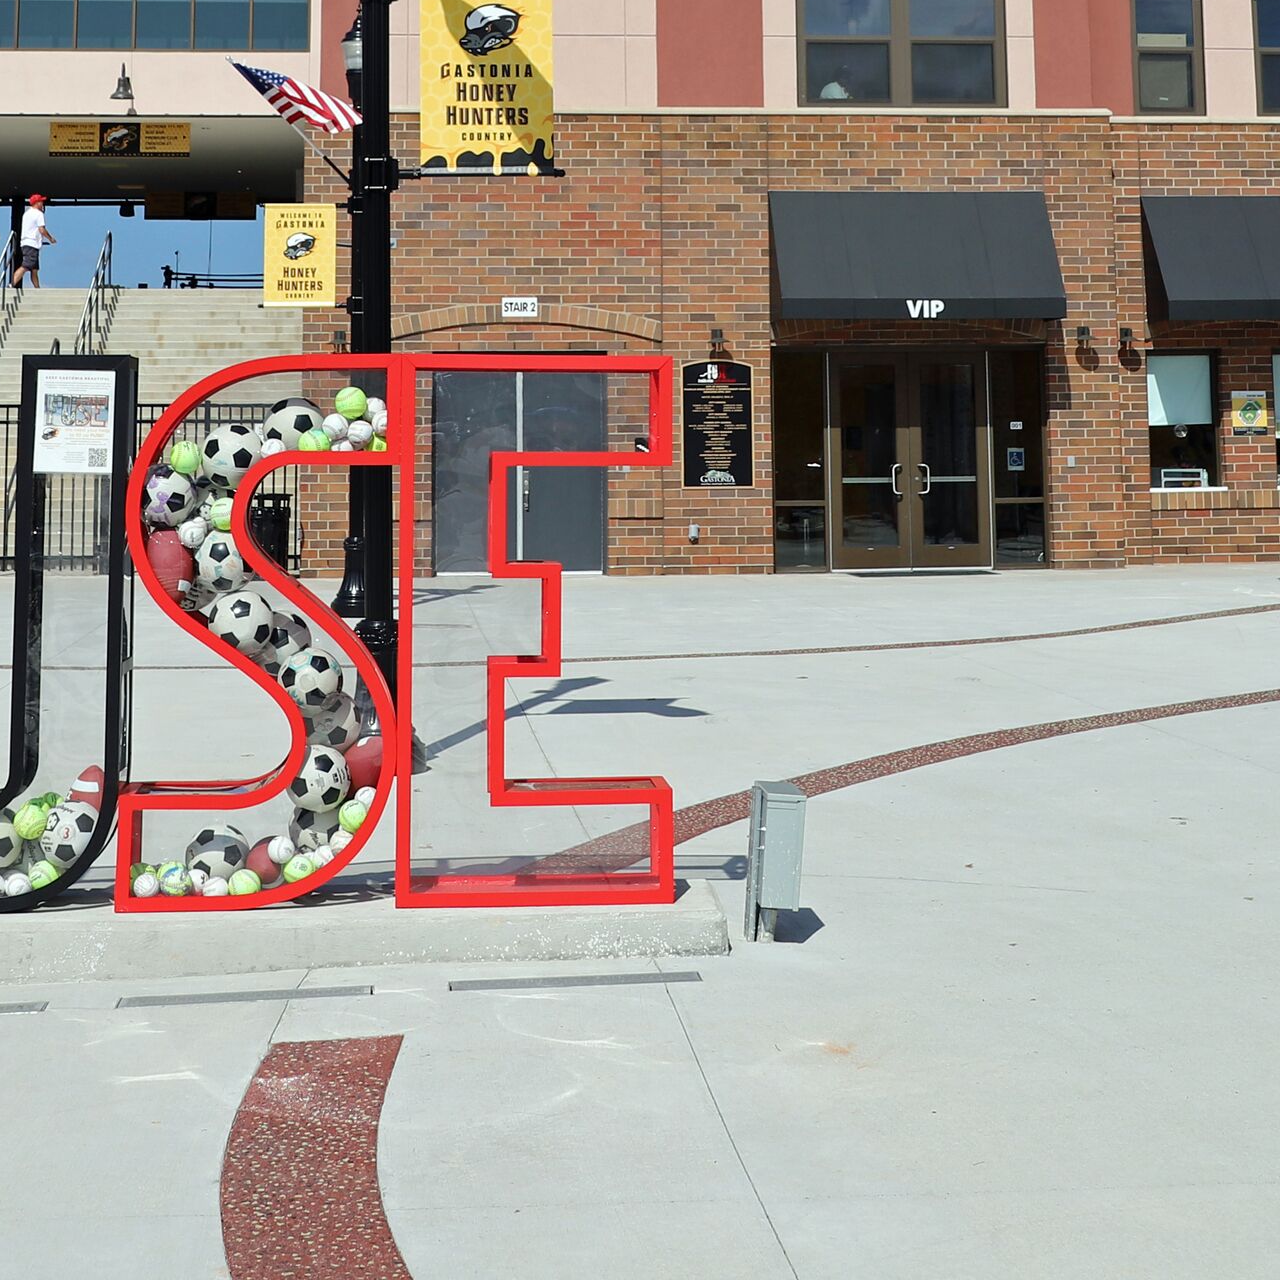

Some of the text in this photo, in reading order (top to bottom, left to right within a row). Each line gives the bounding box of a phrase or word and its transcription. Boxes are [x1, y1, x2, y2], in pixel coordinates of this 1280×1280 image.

[441, 63, 533, 79] GASTONIA
[456, 82, 517, 102] HONEY
[446, 105, 529, 126] HUNTERS
[462, 132, 513, 141] COUNTRY
[276, 220, 325, 228] GASTONIA
[283, 267, 317, 278] HONEY
[277, 280, 323, 291] HUNTERS
[504, 302, 536, 312] STAIR 2
[906, 300, 945, 318] VIP
[63, 827, 70, 840] 3
